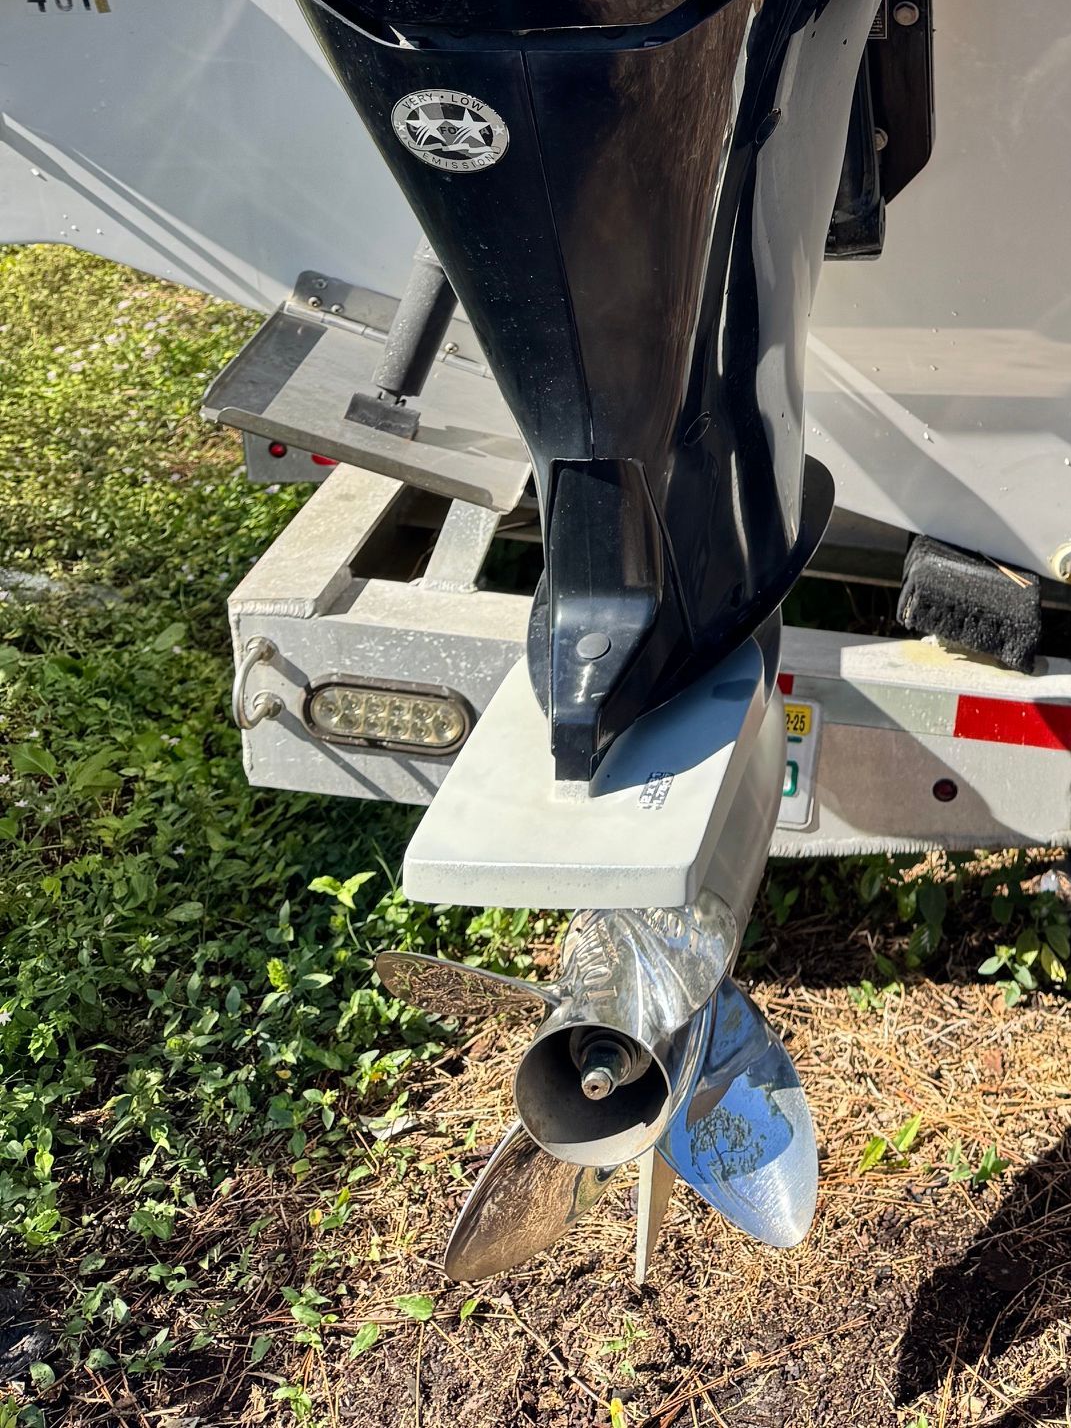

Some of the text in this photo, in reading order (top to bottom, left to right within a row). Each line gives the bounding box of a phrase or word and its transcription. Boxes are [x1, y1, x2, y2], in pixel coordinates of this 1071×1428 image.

[402, 93, 483, 112] VERY LOW
[422, 152, 494, 170] EMISSION
